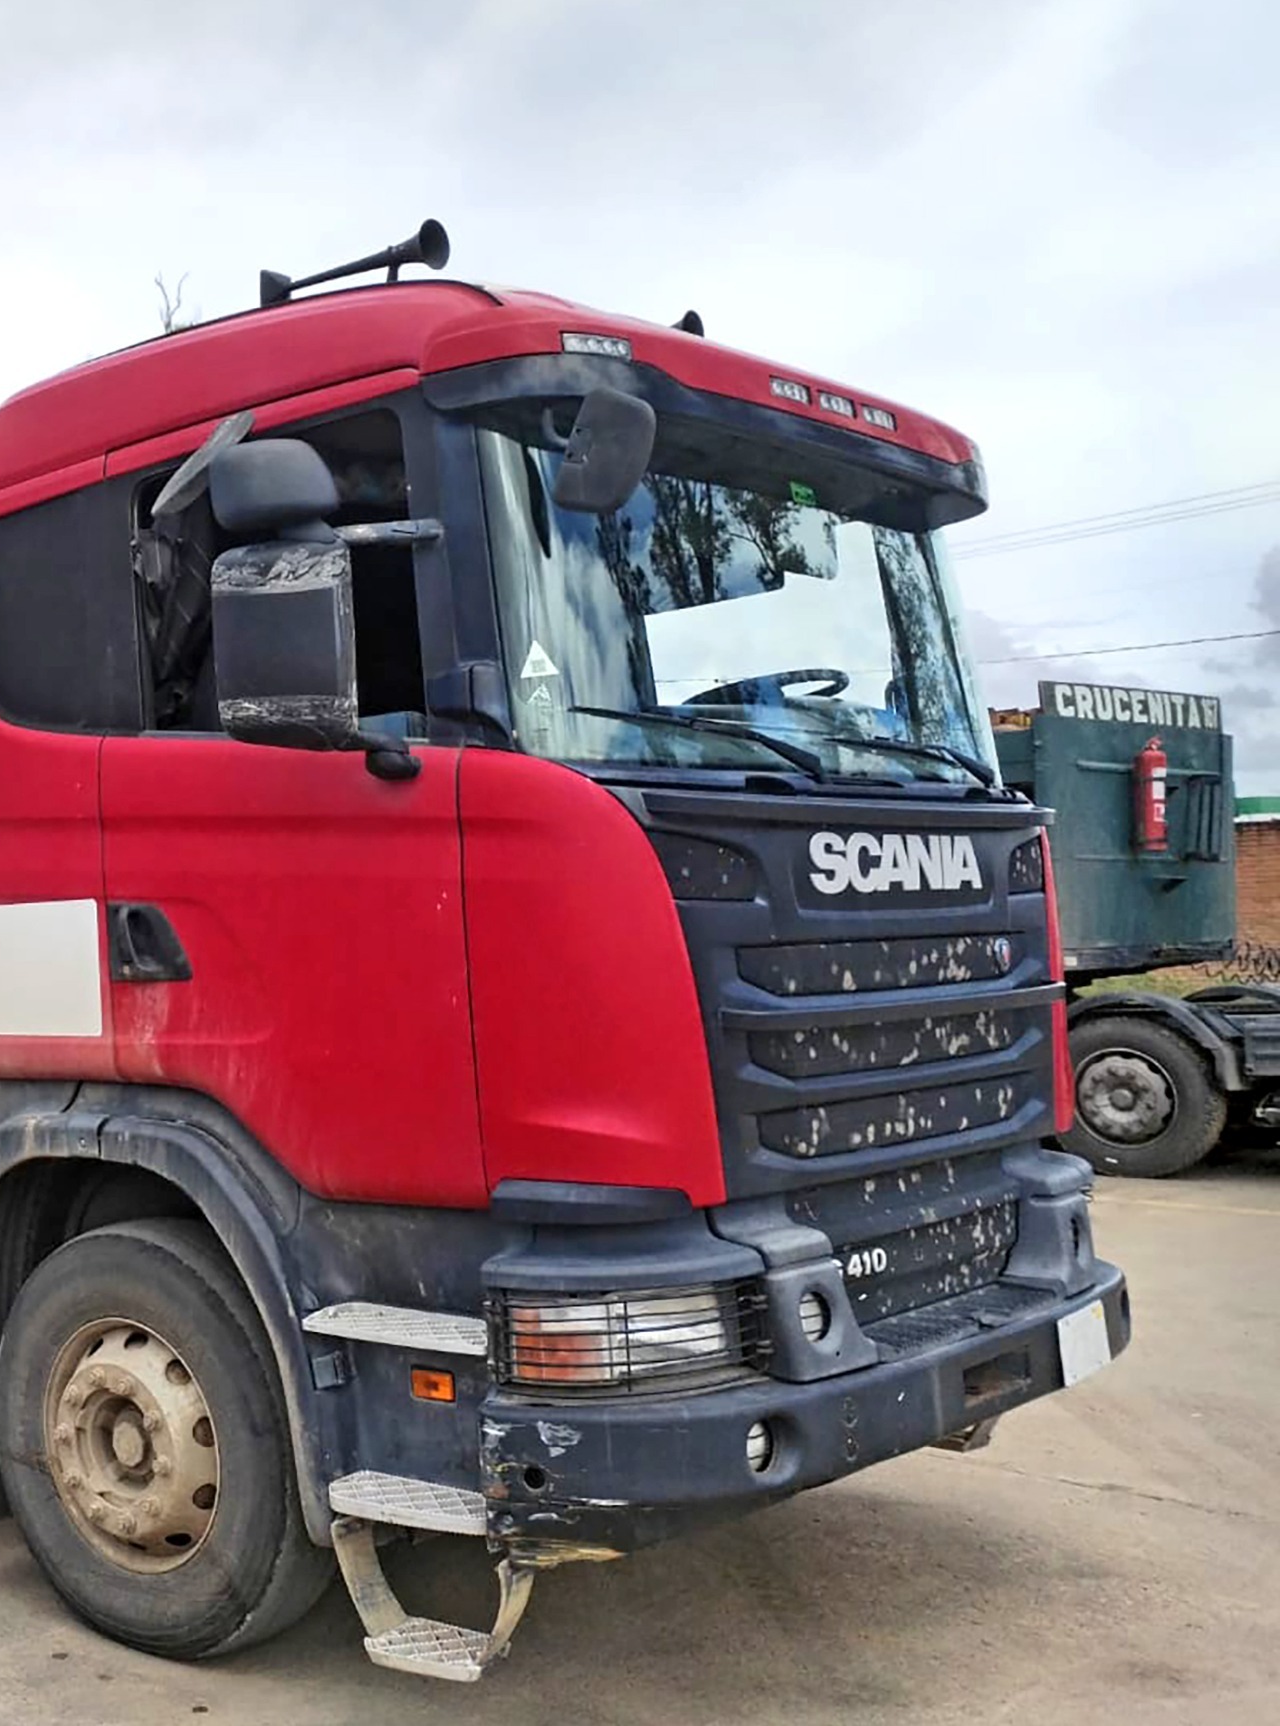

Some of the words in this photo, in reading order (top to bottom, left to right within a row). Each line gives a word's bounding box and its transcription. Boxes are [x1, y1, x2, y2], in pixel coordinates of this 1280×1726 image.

[1054, 684, 1201, 728] CRUCENITA
[809, 832, 983, 894] SCANIA
[847, 1248, 887, 1277] 410
